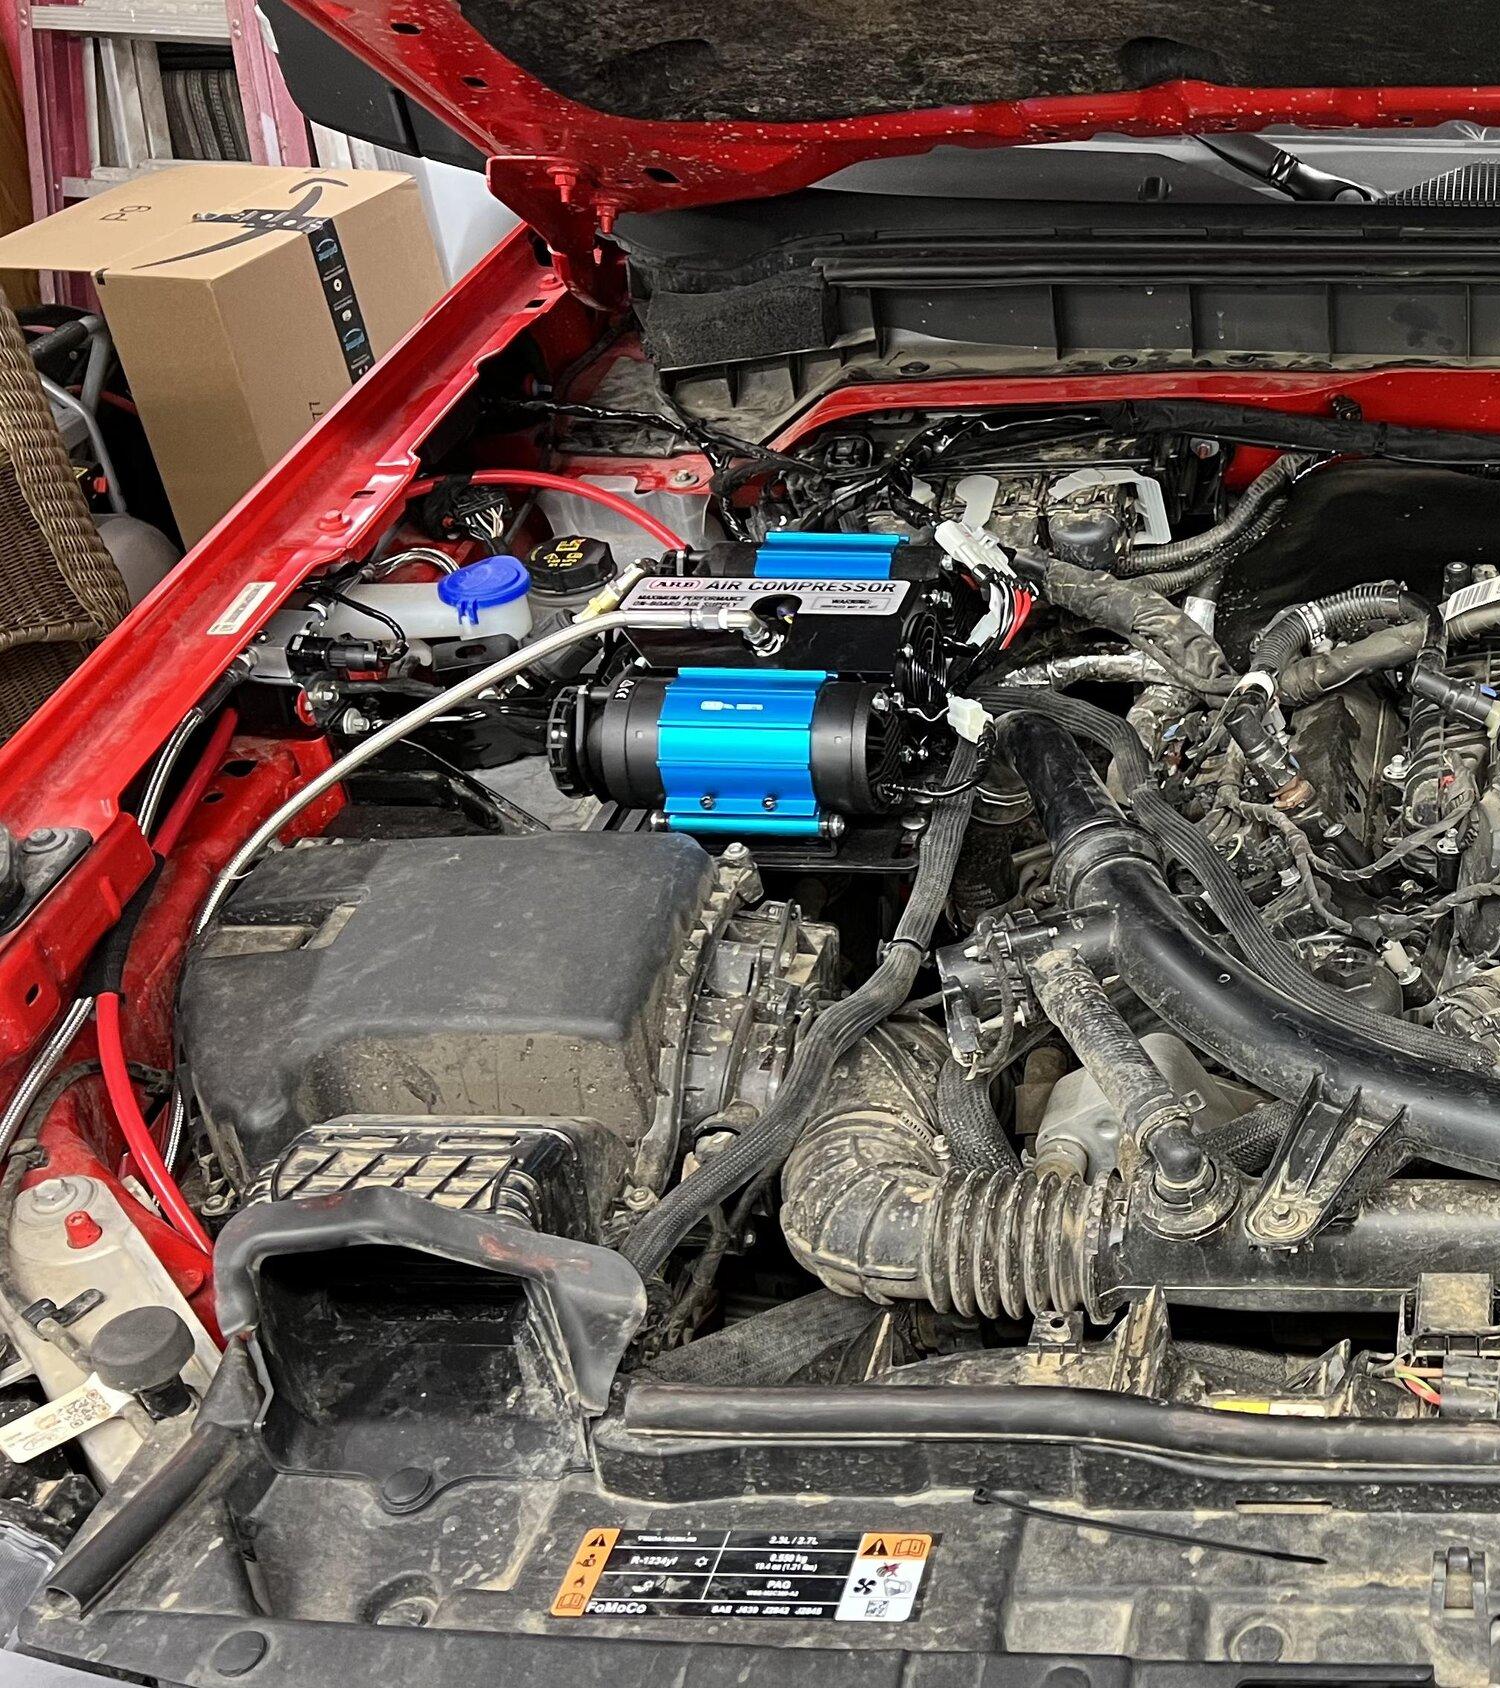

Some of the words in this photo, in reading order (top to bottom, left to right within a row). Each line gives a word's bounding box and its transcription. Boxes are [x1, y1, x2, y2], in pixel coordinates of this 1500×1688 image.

[705, 580, 743, 591] AIR
[748, 580, 897, 593] COMPRESSOR
[630, 1555, 679, 1567] R-1234yf
[585, 1601, 647, 1613] FoMoCo
